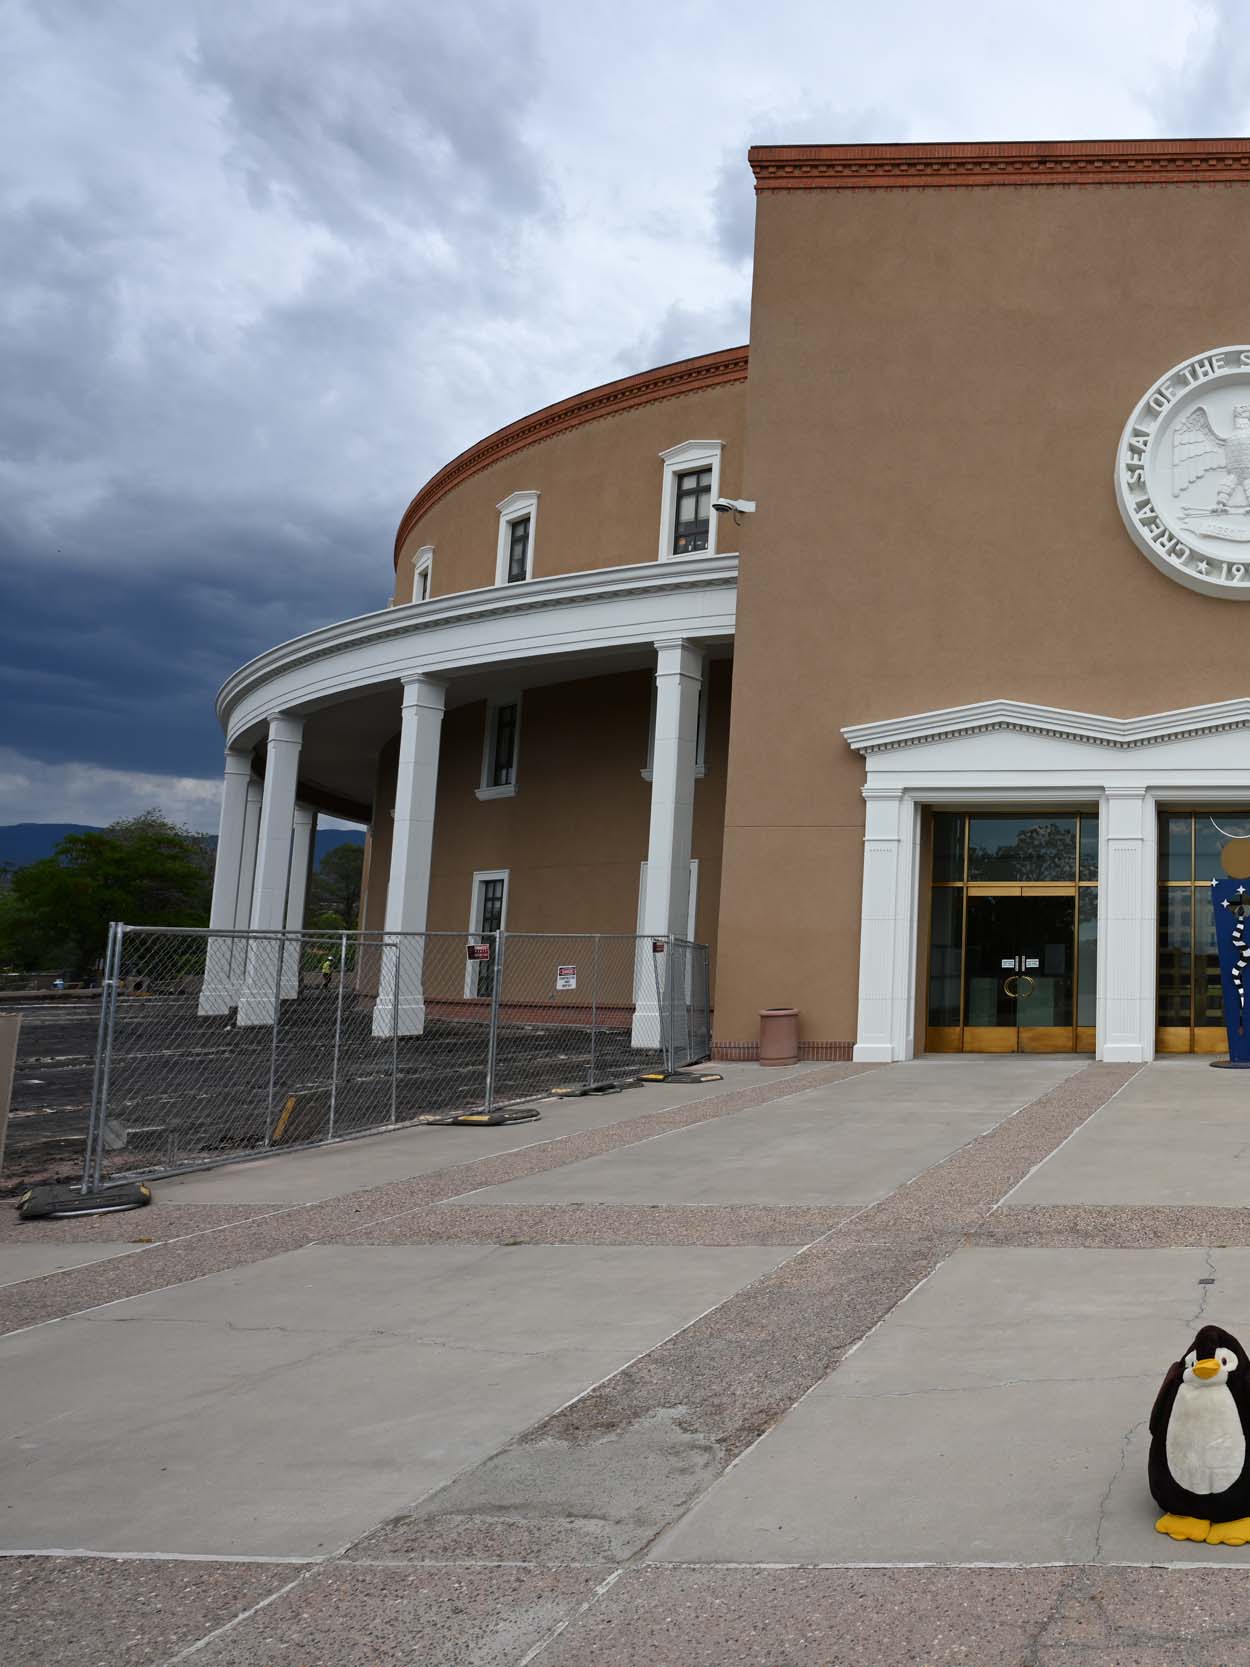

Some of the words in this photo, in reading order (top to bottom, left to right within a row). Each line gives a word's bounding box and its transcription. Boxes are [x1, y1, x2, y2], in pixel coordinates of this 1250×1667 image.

[1179, 354, 1226, 386] THE
[1150, 380, 1178, 412] OF
[1126, 424, 1152, 484] SEAL
[1134, 496, 1191, 563] GREAT
